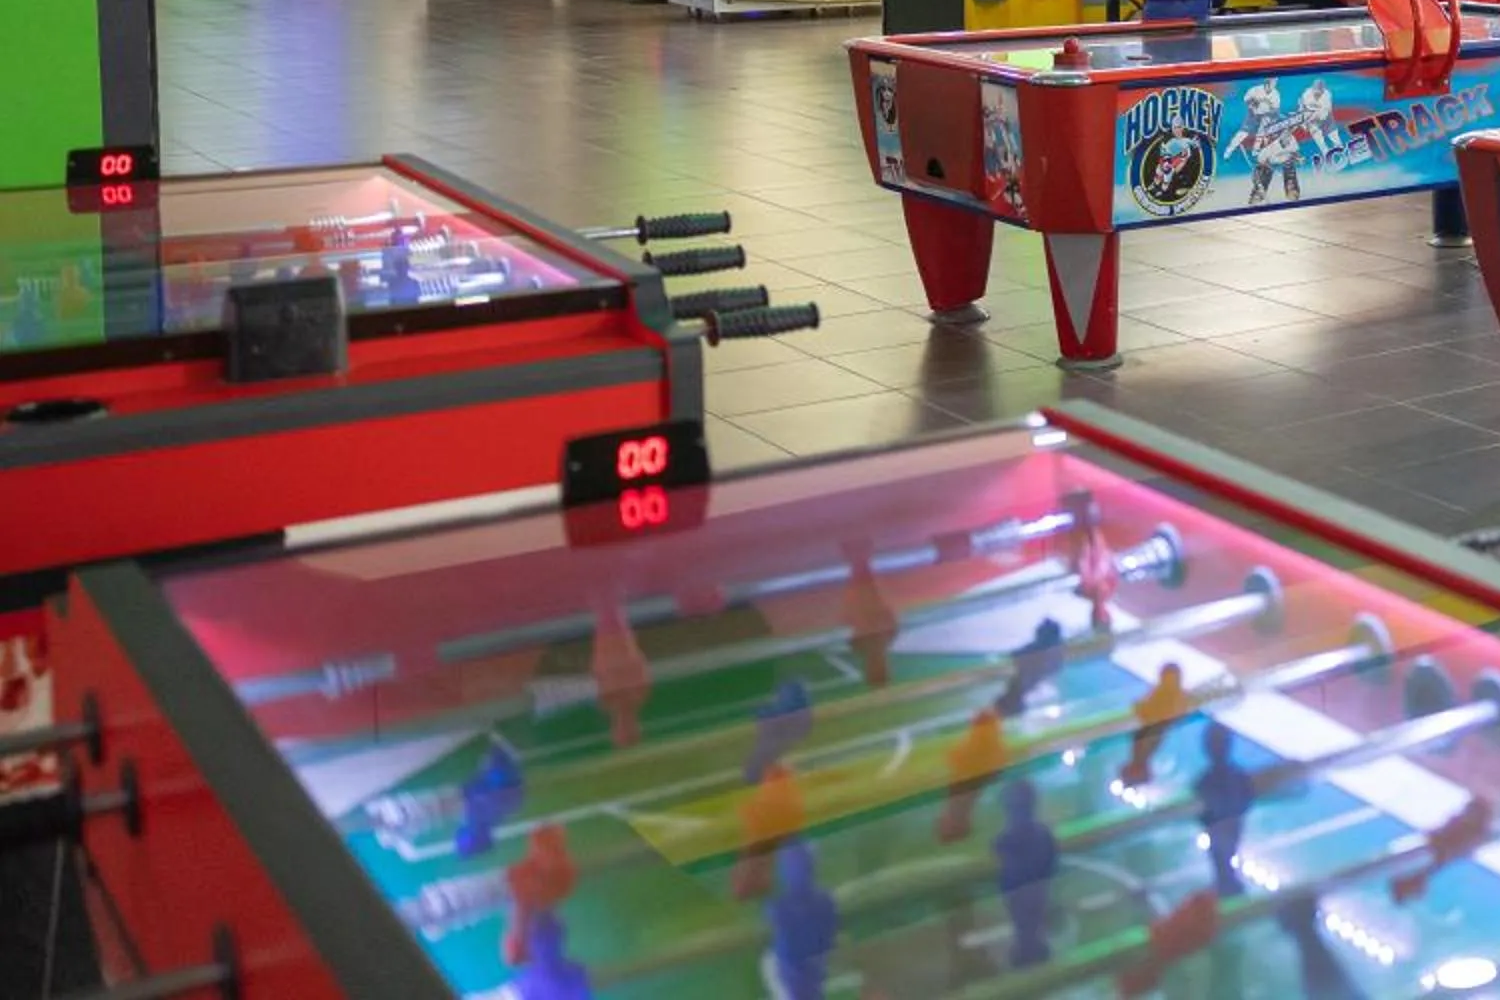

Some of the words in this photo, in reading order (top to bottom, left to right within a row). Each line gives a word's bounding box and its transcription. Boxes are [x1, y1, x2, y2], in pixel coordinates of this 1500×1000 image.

[1123, 85, 1225, 157] HOCKEY
[1346, 83, 1495, 163] TRACK
[101, 153, 133, 176] 00
[617, 436, 669, 479] 00
